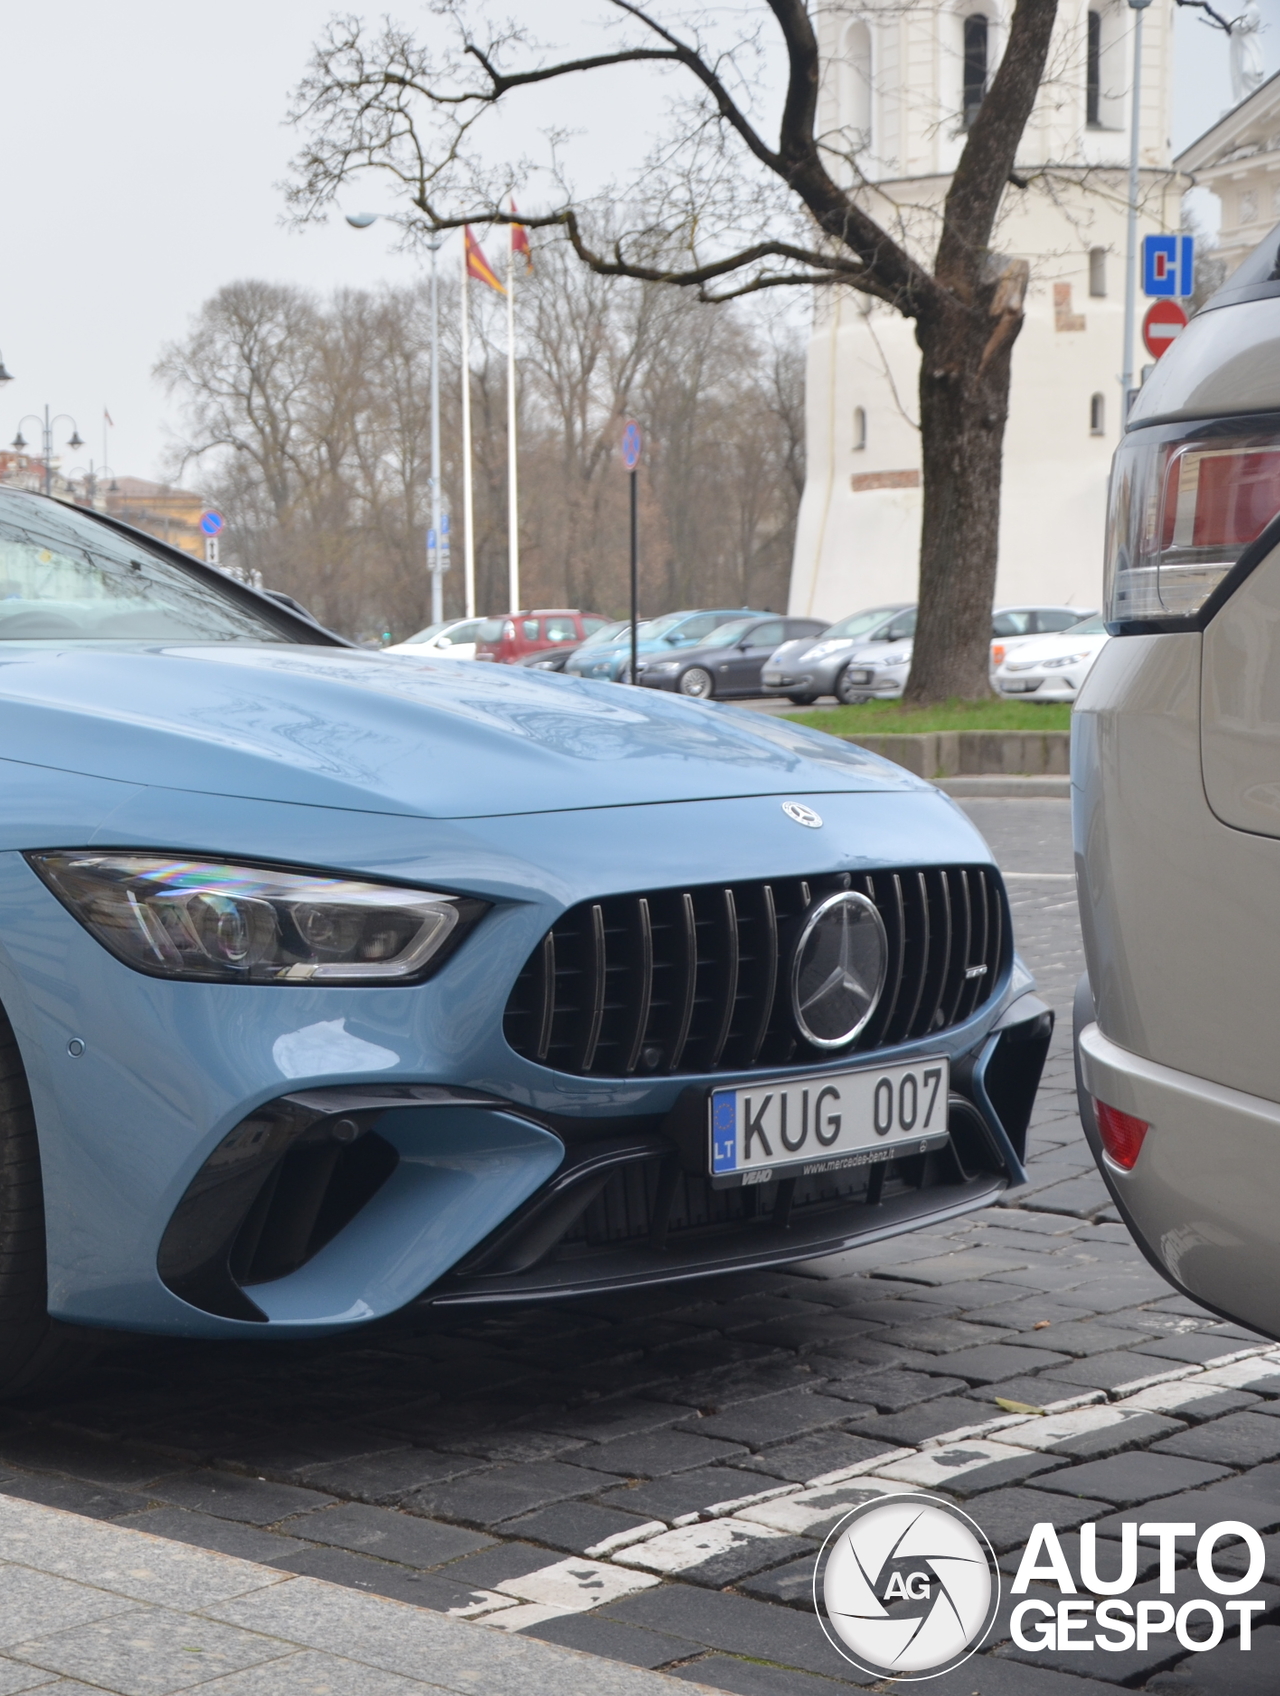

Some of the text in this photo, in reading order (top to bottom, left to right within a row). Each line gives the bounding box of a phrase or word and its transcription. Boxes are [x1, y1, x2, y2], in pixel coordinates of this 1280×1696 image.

[743, 1065, 943, 1161] KUG 007
[714, 1140, 734, 1160] LT
[803, 1147, 895, 1176] www.mercedes-benz.lt
[741, 1169, 773, 1186] VEHO
